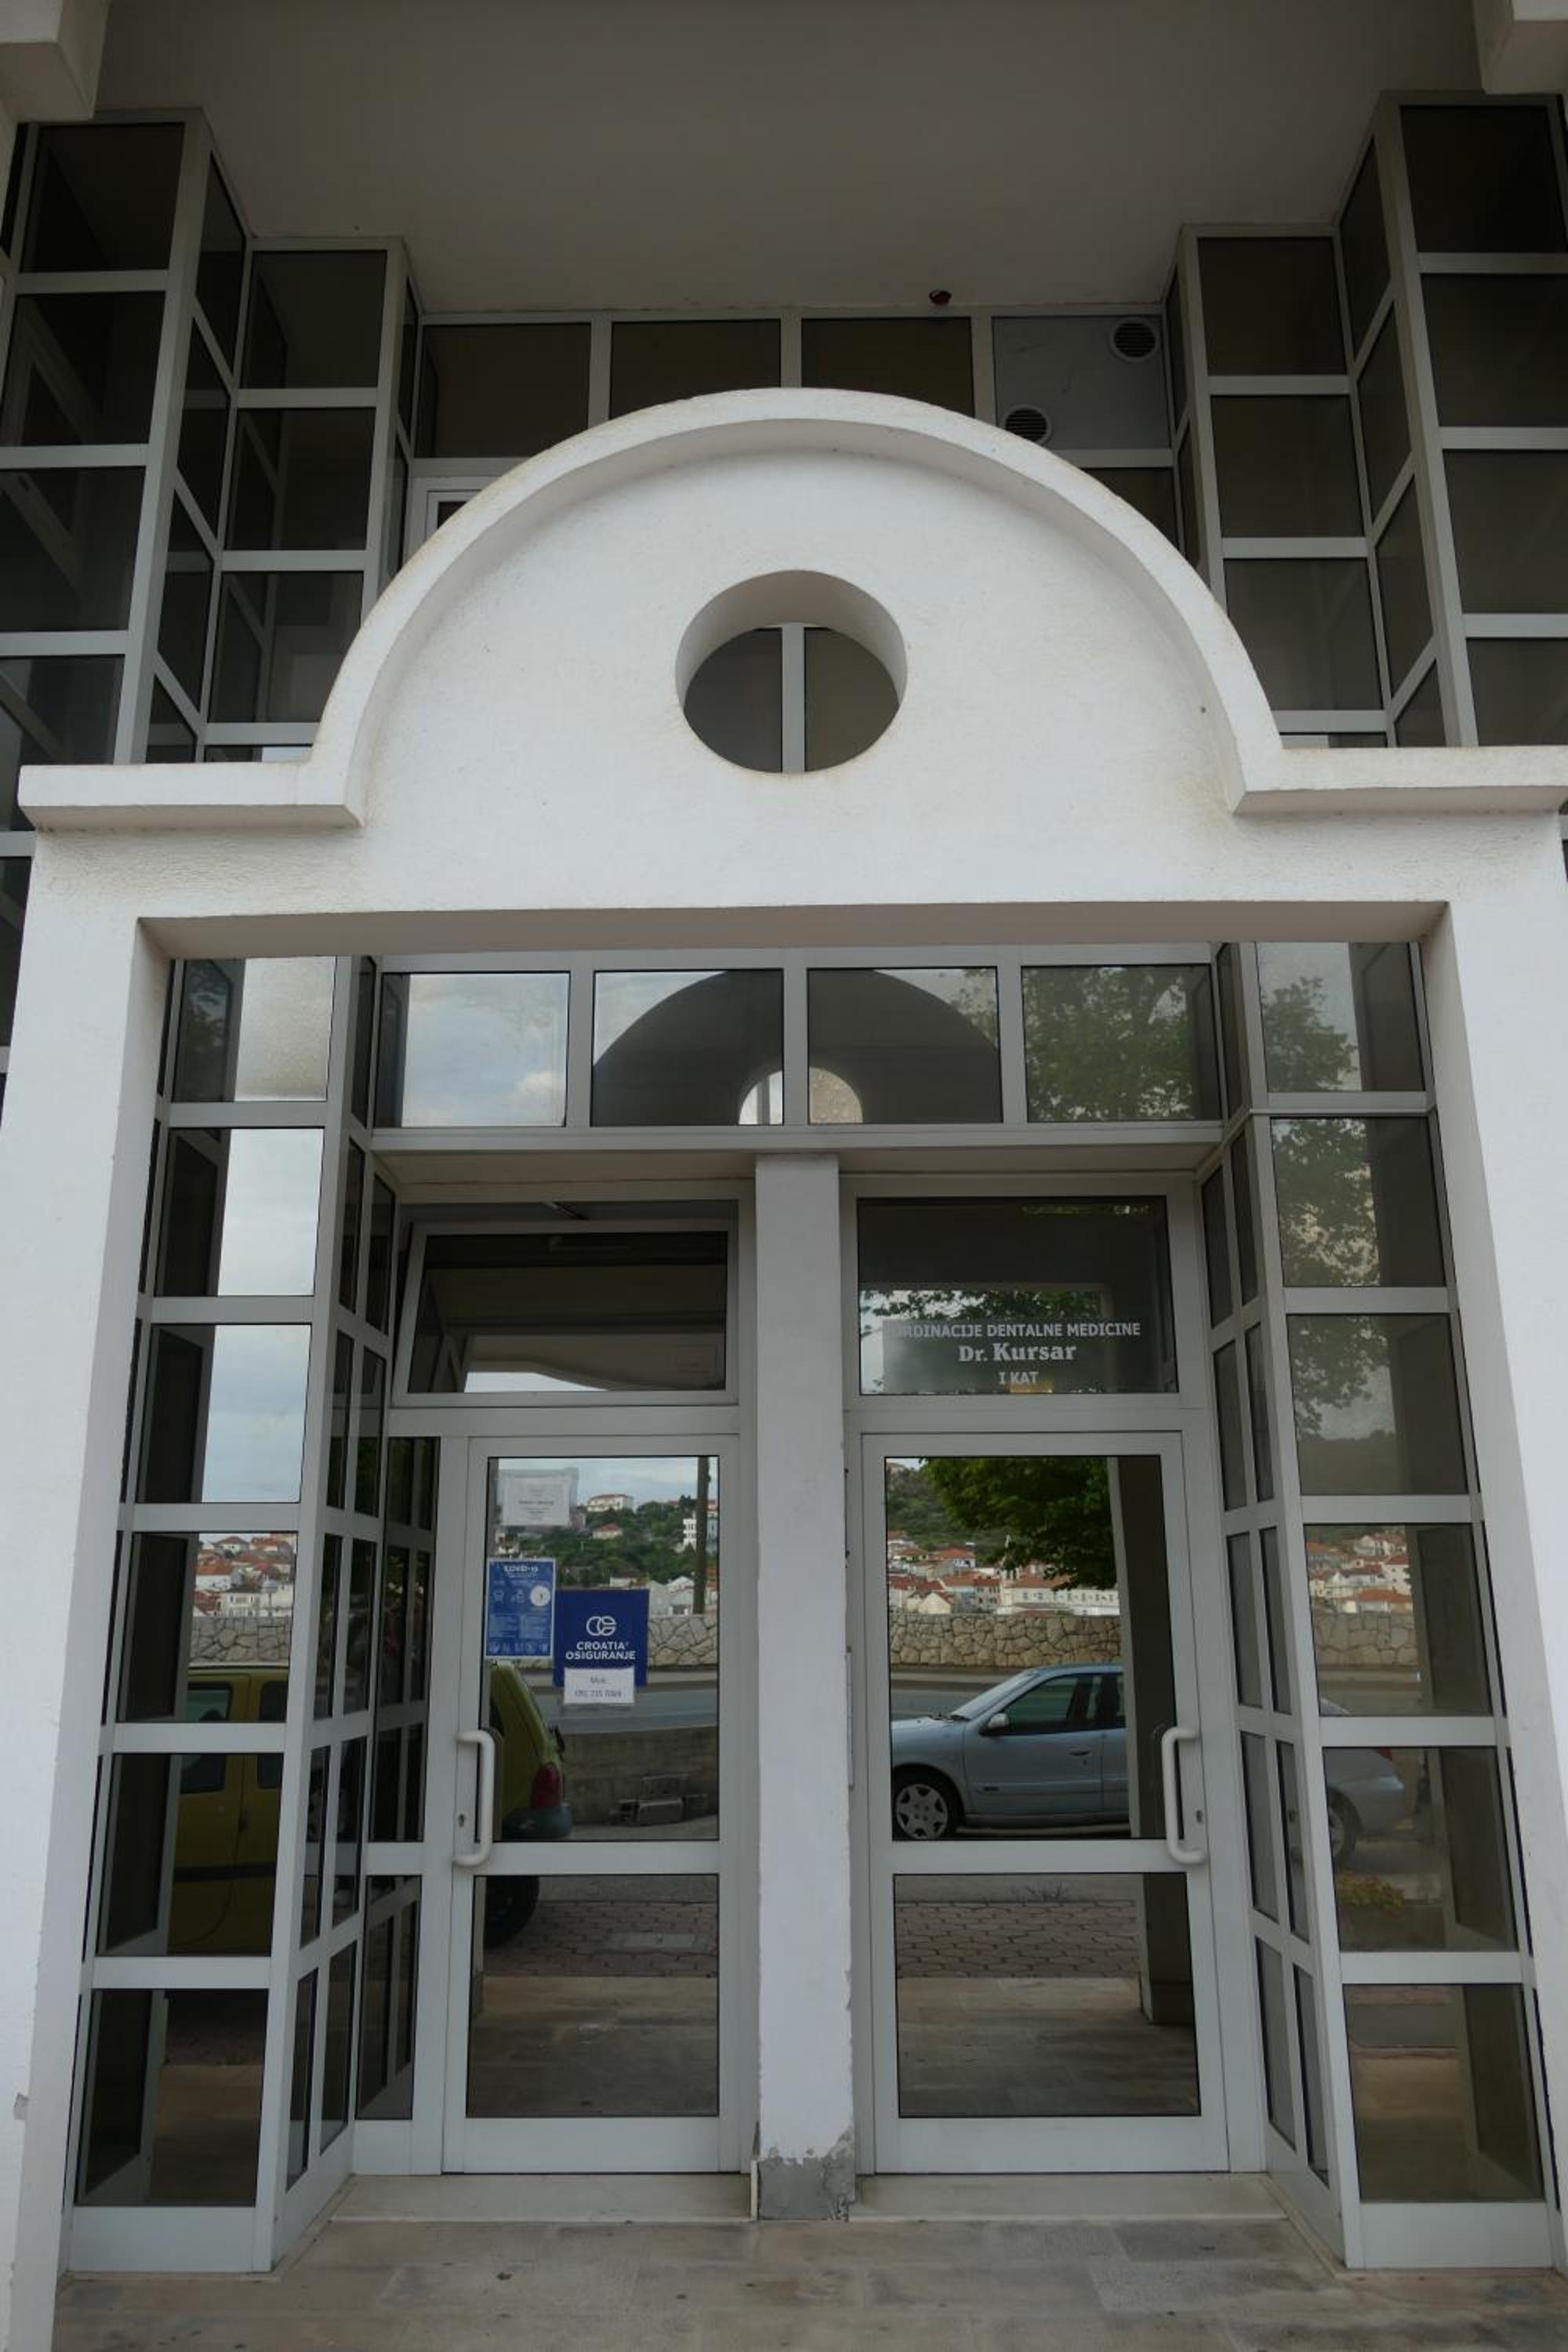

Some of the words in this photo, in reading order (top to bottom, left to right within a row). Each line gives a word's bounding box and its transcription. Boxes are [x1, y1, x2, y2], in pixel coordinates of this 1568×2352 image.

[893, 1324, 982, 1338] RDINACIJE
[987, 1323, 1062, 1337] DENTALNE
[1067, 1323, 1141, 1336] MEDICINE
[959, 1345, 989, 1363] Dr.
[993, 1342, 1076, 1362] Kursar
[999, 1371, 1006, 1385] I
[1010, 1370, 1040, 1385] KAT
[576, 1640, 626, 1651] CROATIA
[565, 1650, 636, 1661] OSIGURANJE
